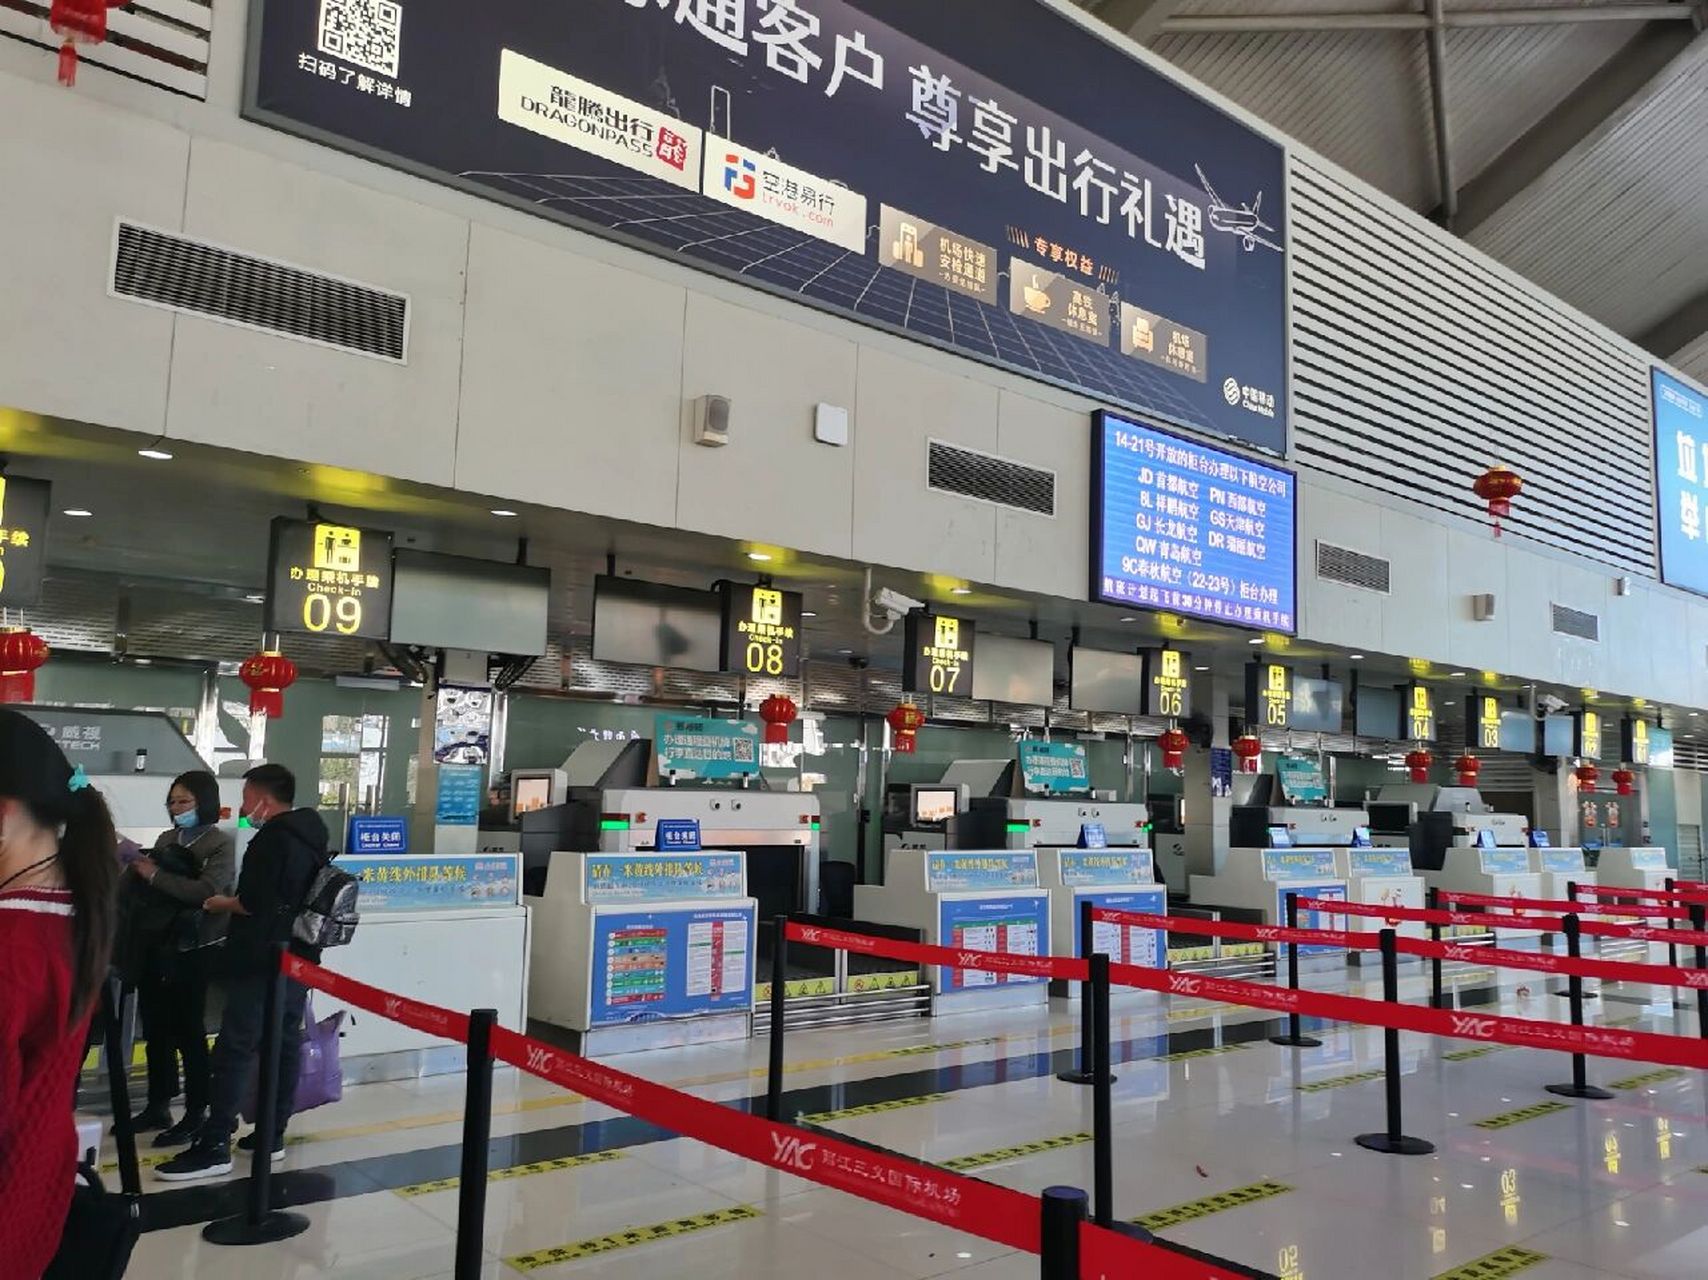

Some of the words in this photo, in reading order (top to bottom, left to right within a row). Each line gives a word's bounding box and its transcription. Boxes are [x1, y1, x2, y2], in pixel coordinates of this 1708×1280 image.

[299, 53, 412, 107] 扫码了解详情
[521, 95, 653, 158] DRAGONPASS
[624, 0, 884, 97] 通客户
[906, 64, 1206, 269] 尊享出行礼遇
[763, 171, 834, 215] 空港易行
[1034, 236, 1094, 275] 专享权益
[1137, 467, 1153, 485] JD
[1157, 471, 1199, 500] 首都航空
[1210, 487, 1226, 505] PN
[1136, 513, 1151, 532] GJ
[1155, 516, 1199, 543] 长龙航空
[1208, 531, 1224, 549] DR
[1136, 536, 1156, 556] QW
[1159, 540, 1202, 567] 青岛航空
[289, 566, 380, 589] 办理乘机手续
[307, 582, 362, 597] Check-in
[303, 593, 362, 635] 09
[746, 642, 784, 675] 08
[929, 665, 960, 693] 07
[1160, 691, 1181, 715] 06
[1267, 703, 1286, 725] 05
[1413, 721, 1429, 740] 04
[1485, 728, 1498, 748] 03
[801, 928, 822, 942] YAC
[957, 951, 982, 969] YAC
[1443, 944, 1474, 960] YAC
[1168, 975, 1201, 994] YAC
[1452, 1015, 1497, 1038] YAC
[527, 1044, 554, 1074] YAC
[771, 1131, 817, 1170] YAC
